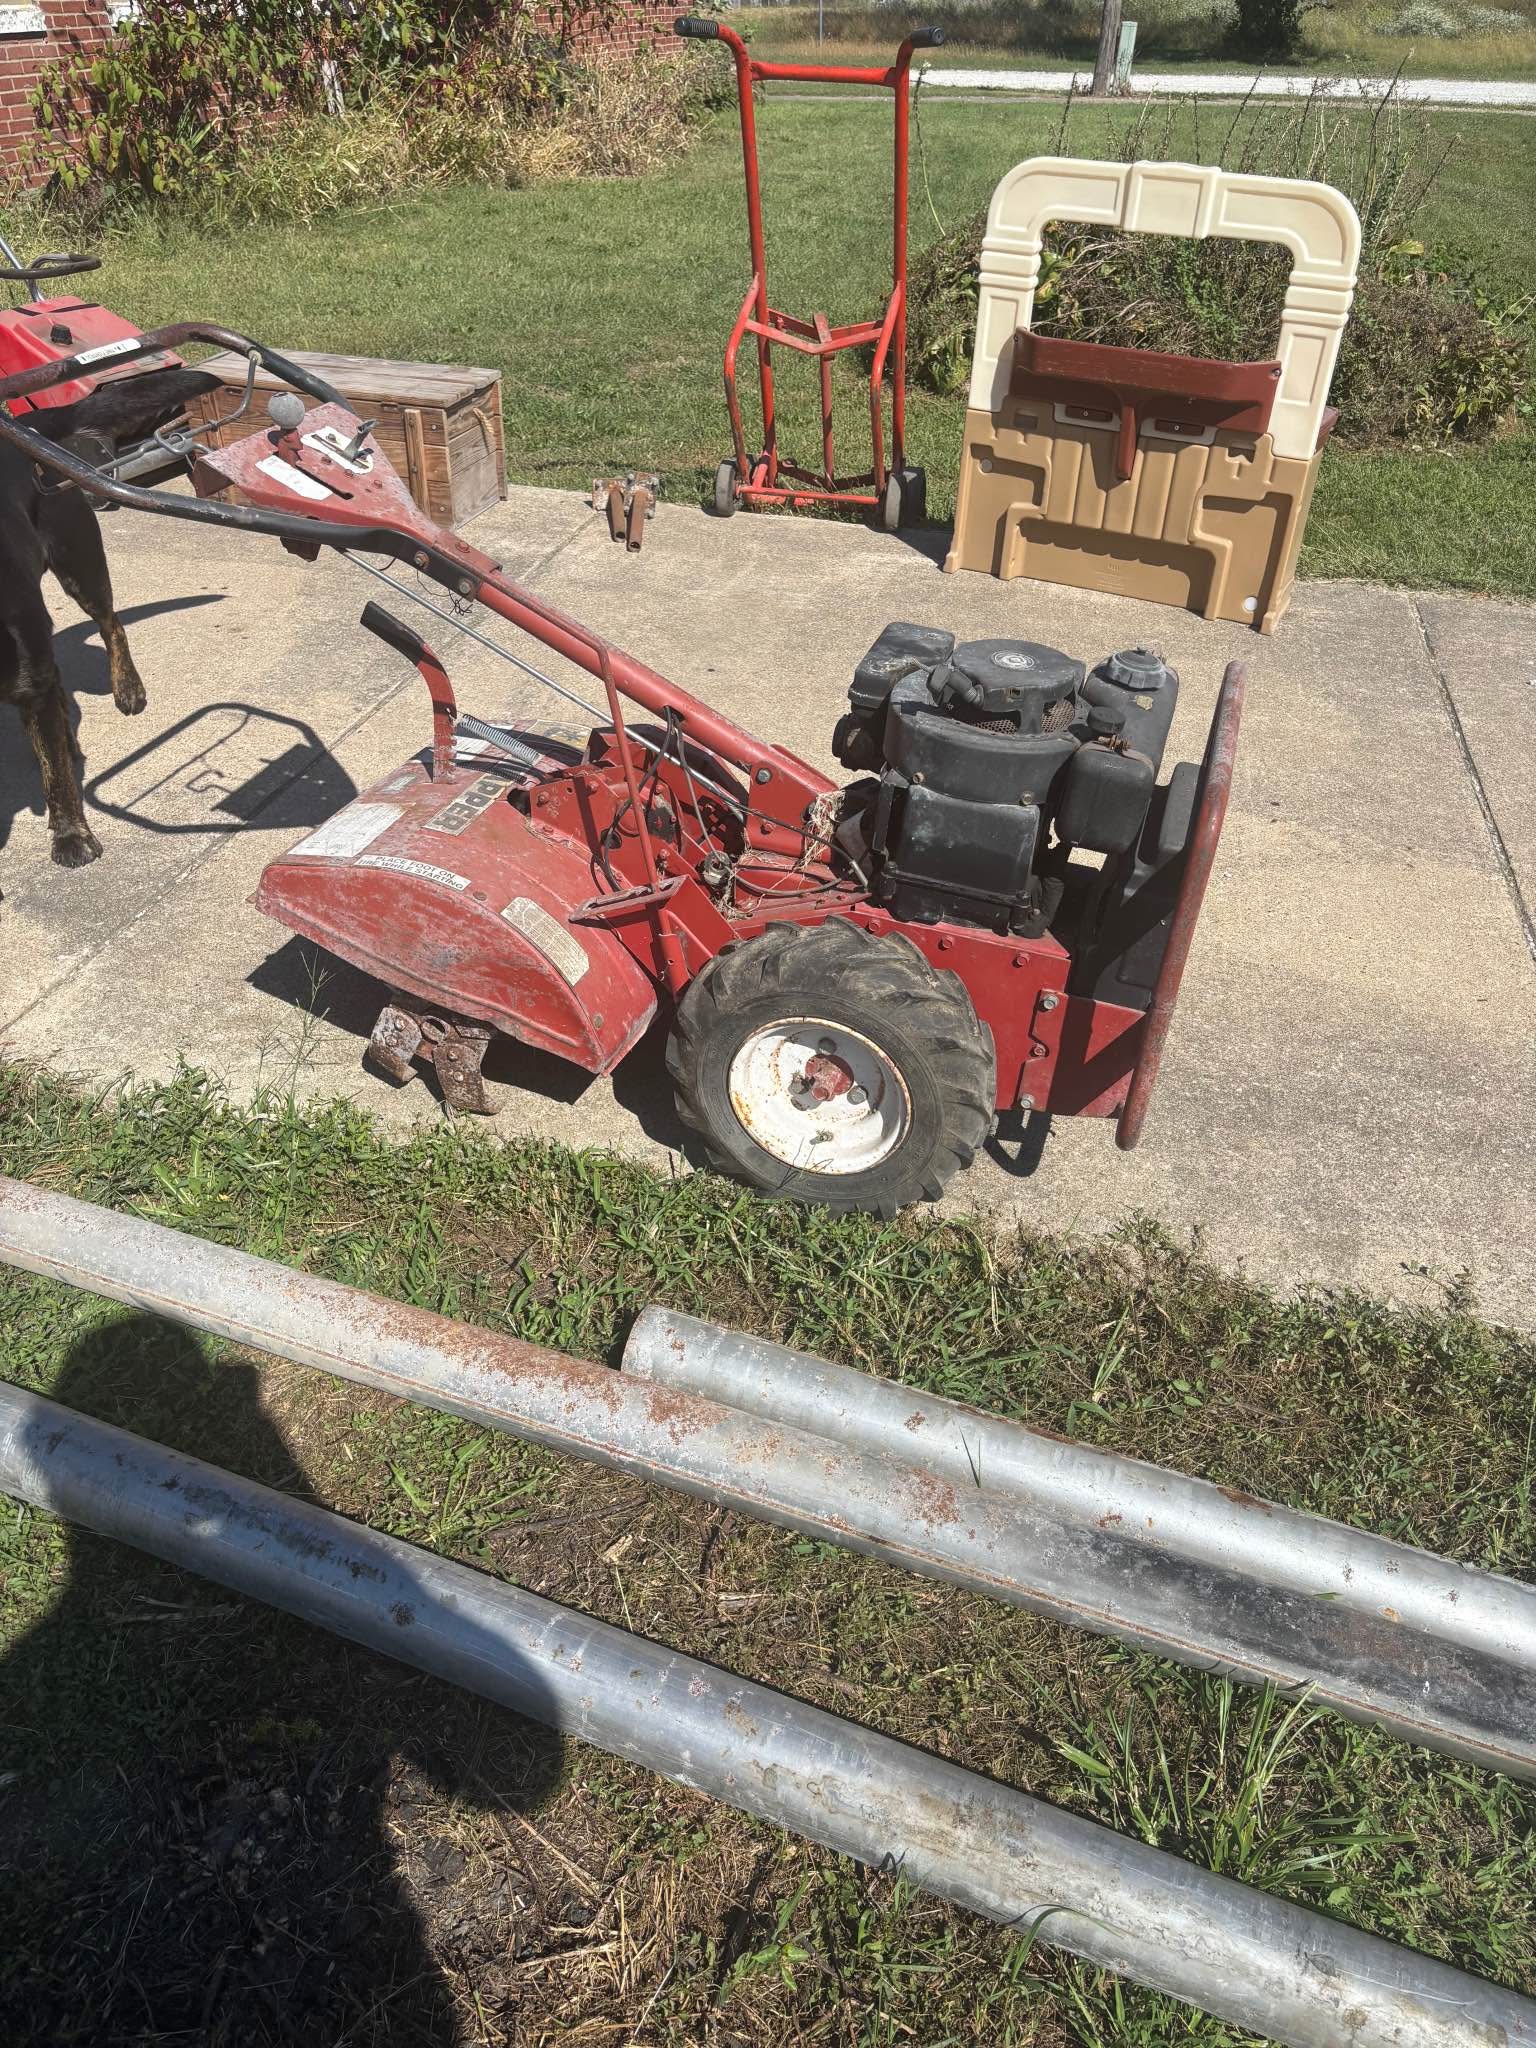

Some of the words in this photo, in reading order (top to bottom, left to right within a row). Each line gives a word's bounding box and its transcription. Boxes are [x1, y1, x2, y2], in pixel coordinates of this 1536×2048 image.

[376, 856, 408, 866] PLACE
[410, 861, 435, 872] FOOT
[439, 870, 455, 879] ON
[381, 862, 413, 872] WHILE
[415, 868, 464, 890] STARTING
